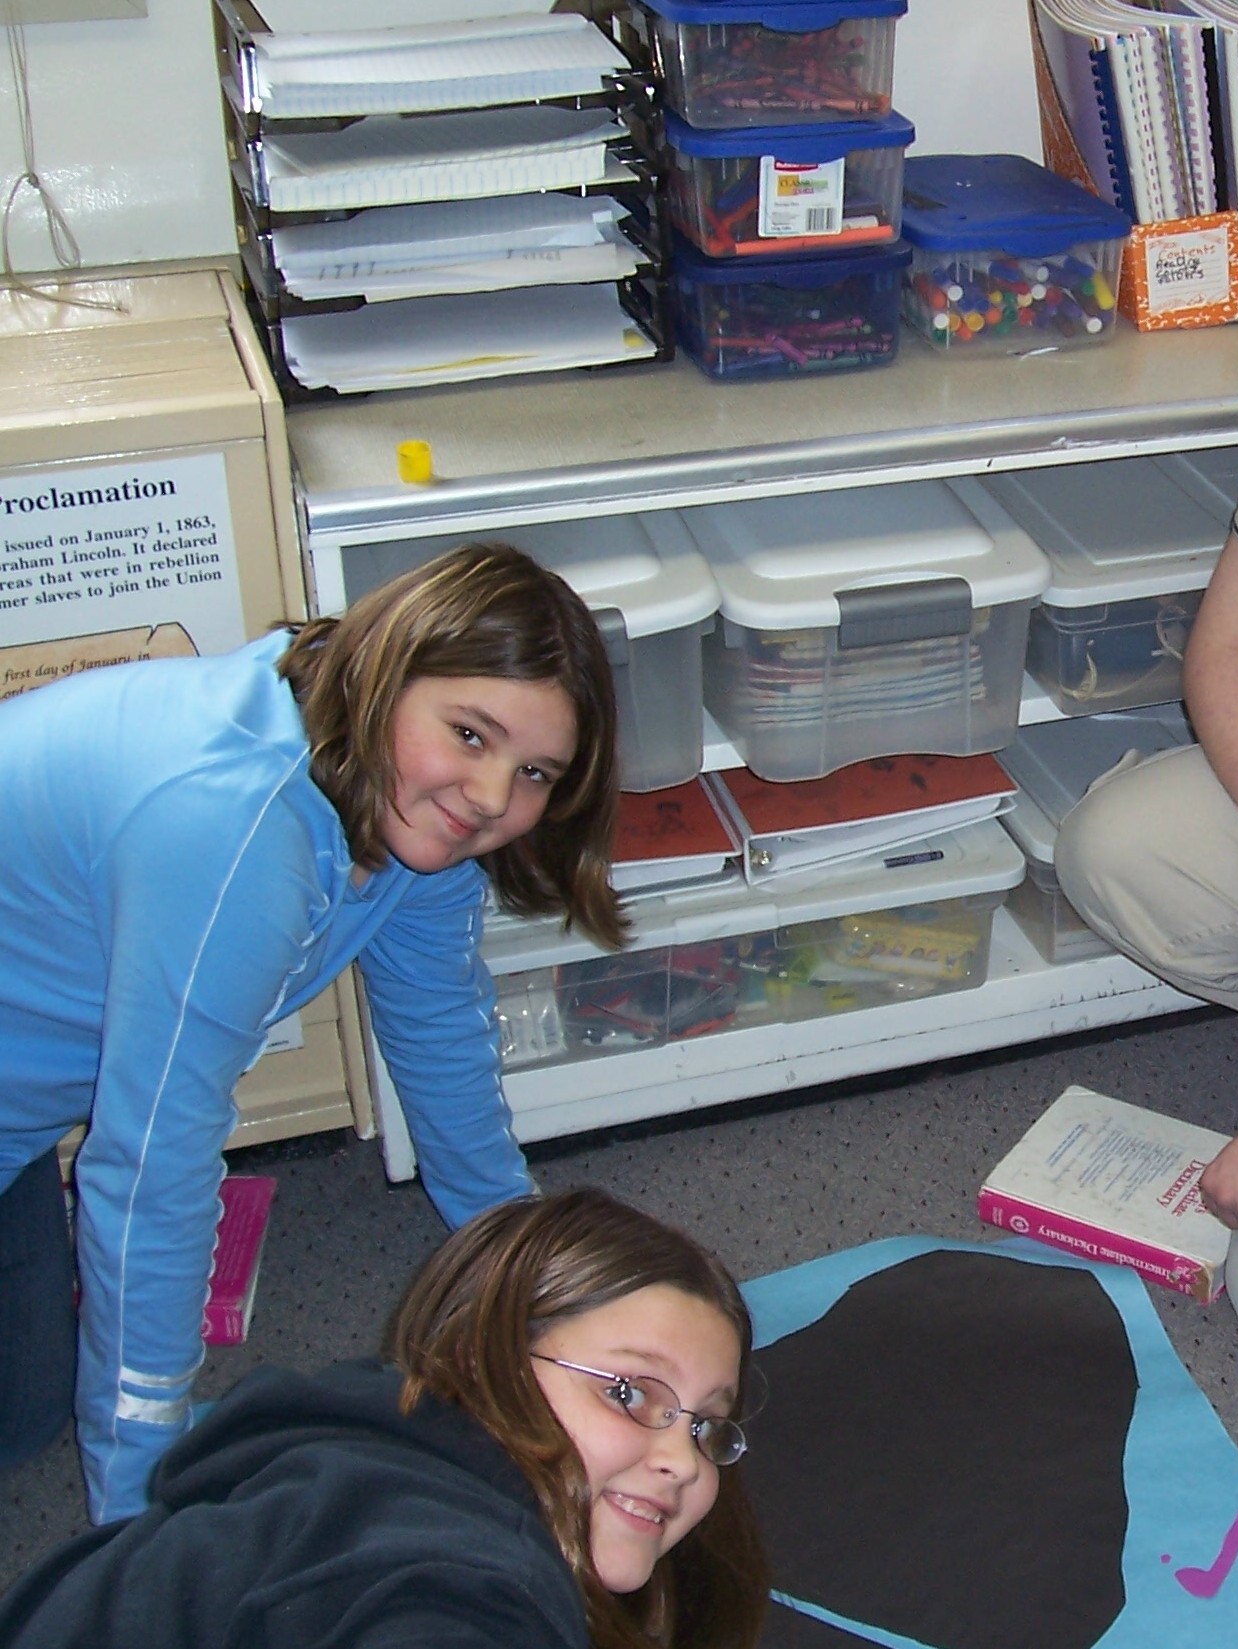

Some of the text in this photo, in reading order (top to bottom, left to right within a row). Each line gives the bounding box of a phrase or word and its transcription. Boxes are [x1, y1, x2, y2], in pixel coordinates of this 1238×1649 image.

[4, 515, 217, 553] issued on January 1, 1863,
[61, 546, 127, 565] Lincoln.
[133, 542, 146, 556] It
[152, 533, 218, 553] declared
[40, 571, 73, 586] that
[80, 566, 119, 580] were
[126, 561, 142, 574] in
[149, 552, 220, 571] rebellion
[35, 591, 82, 605] slaves
[87, 586, 103, 598] to
[108, 580, 140, 598] join
[145, 576, 170, 590] the
[176, 569, 222, 586] Union
[3, 668, 32, 685] first
[35, 663, 60, 679] day
[61, 659, 77, 676] of
[1156, 1159, 1206, 1208] Dictionary
[1038, 1225, 1099, 1255] Dictionary
[1100, 1246, 1172, 1281] Intermediate
